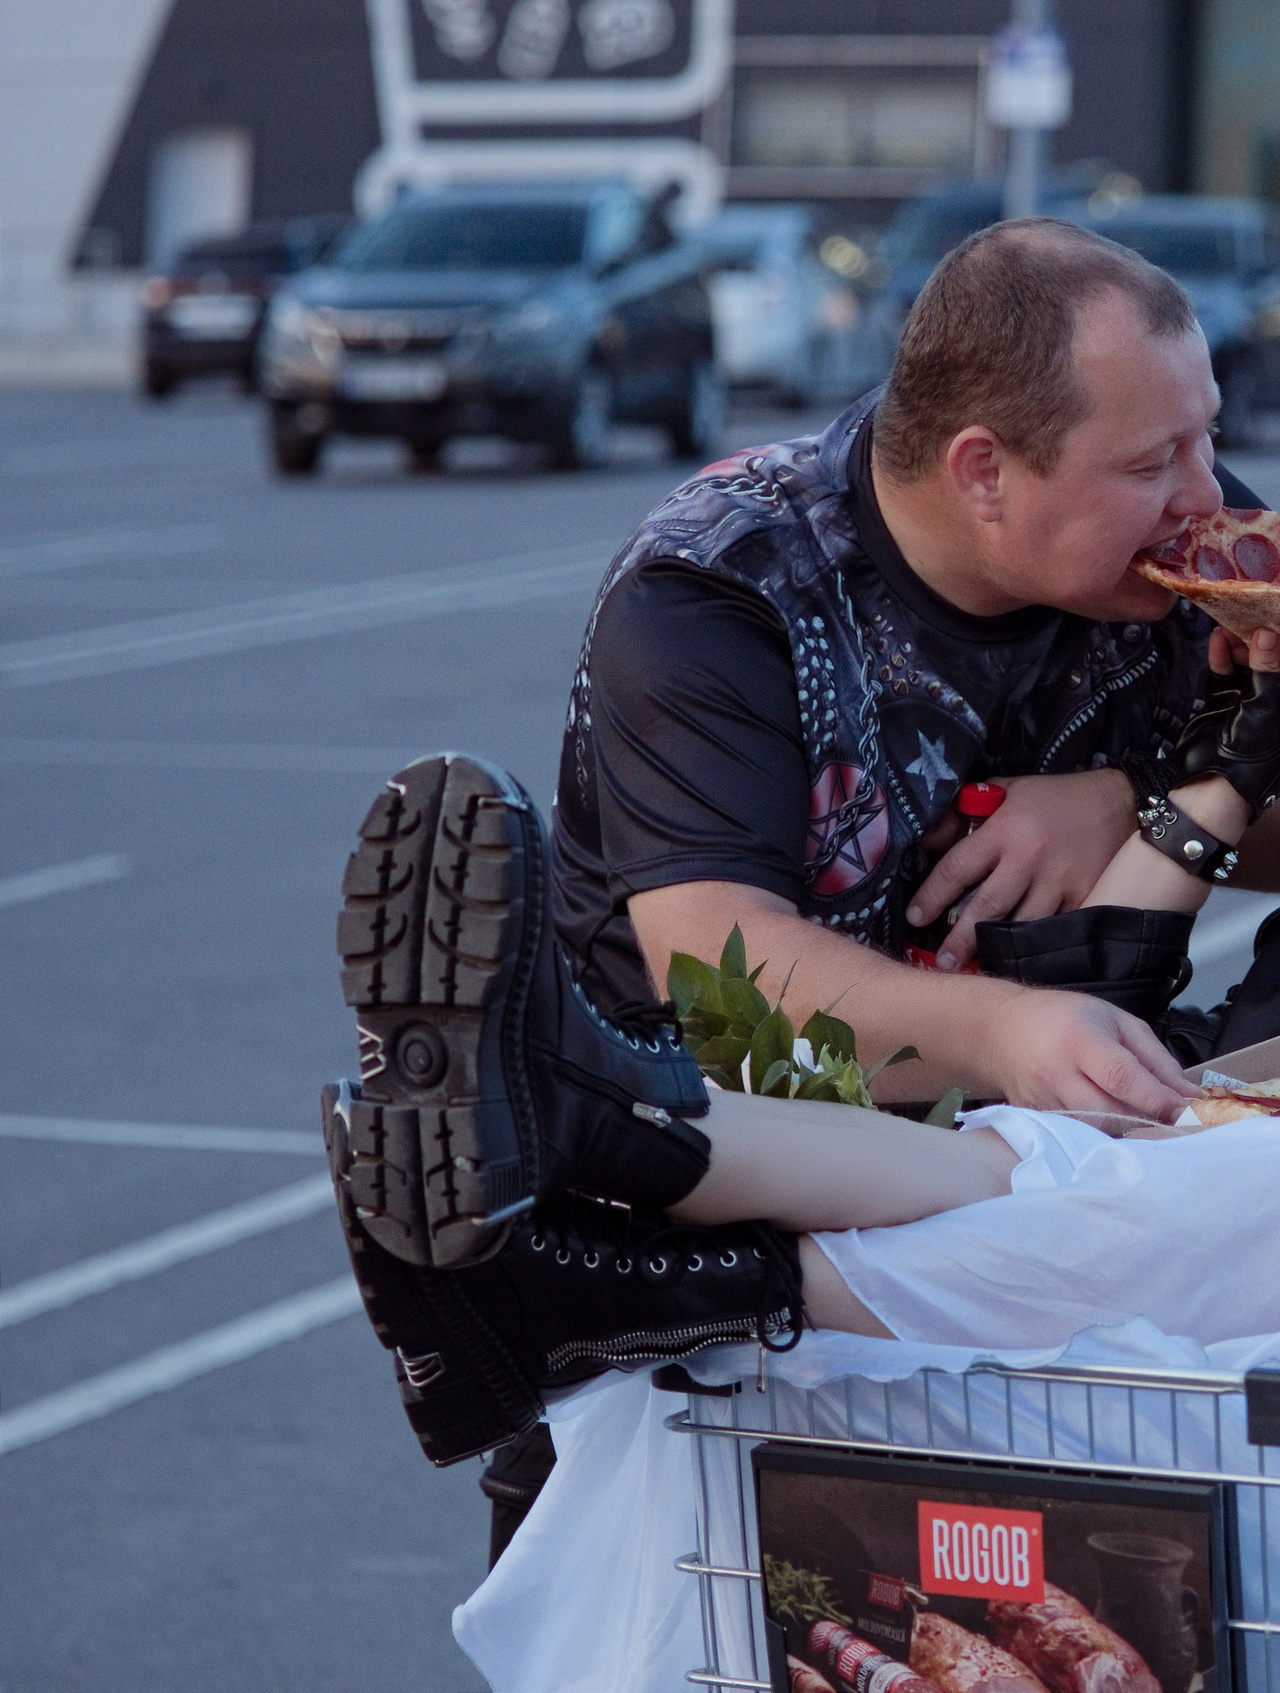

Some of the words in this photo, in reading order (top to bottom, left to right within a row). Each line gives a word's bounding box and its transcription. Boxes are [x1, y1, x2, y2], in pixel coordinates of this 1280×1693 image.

[932, 1518, 1030, 1588] ROGOB
[871, 1578, 901, 1606] ROGOB
[838, 1641, 874, 1676] ROGOB
